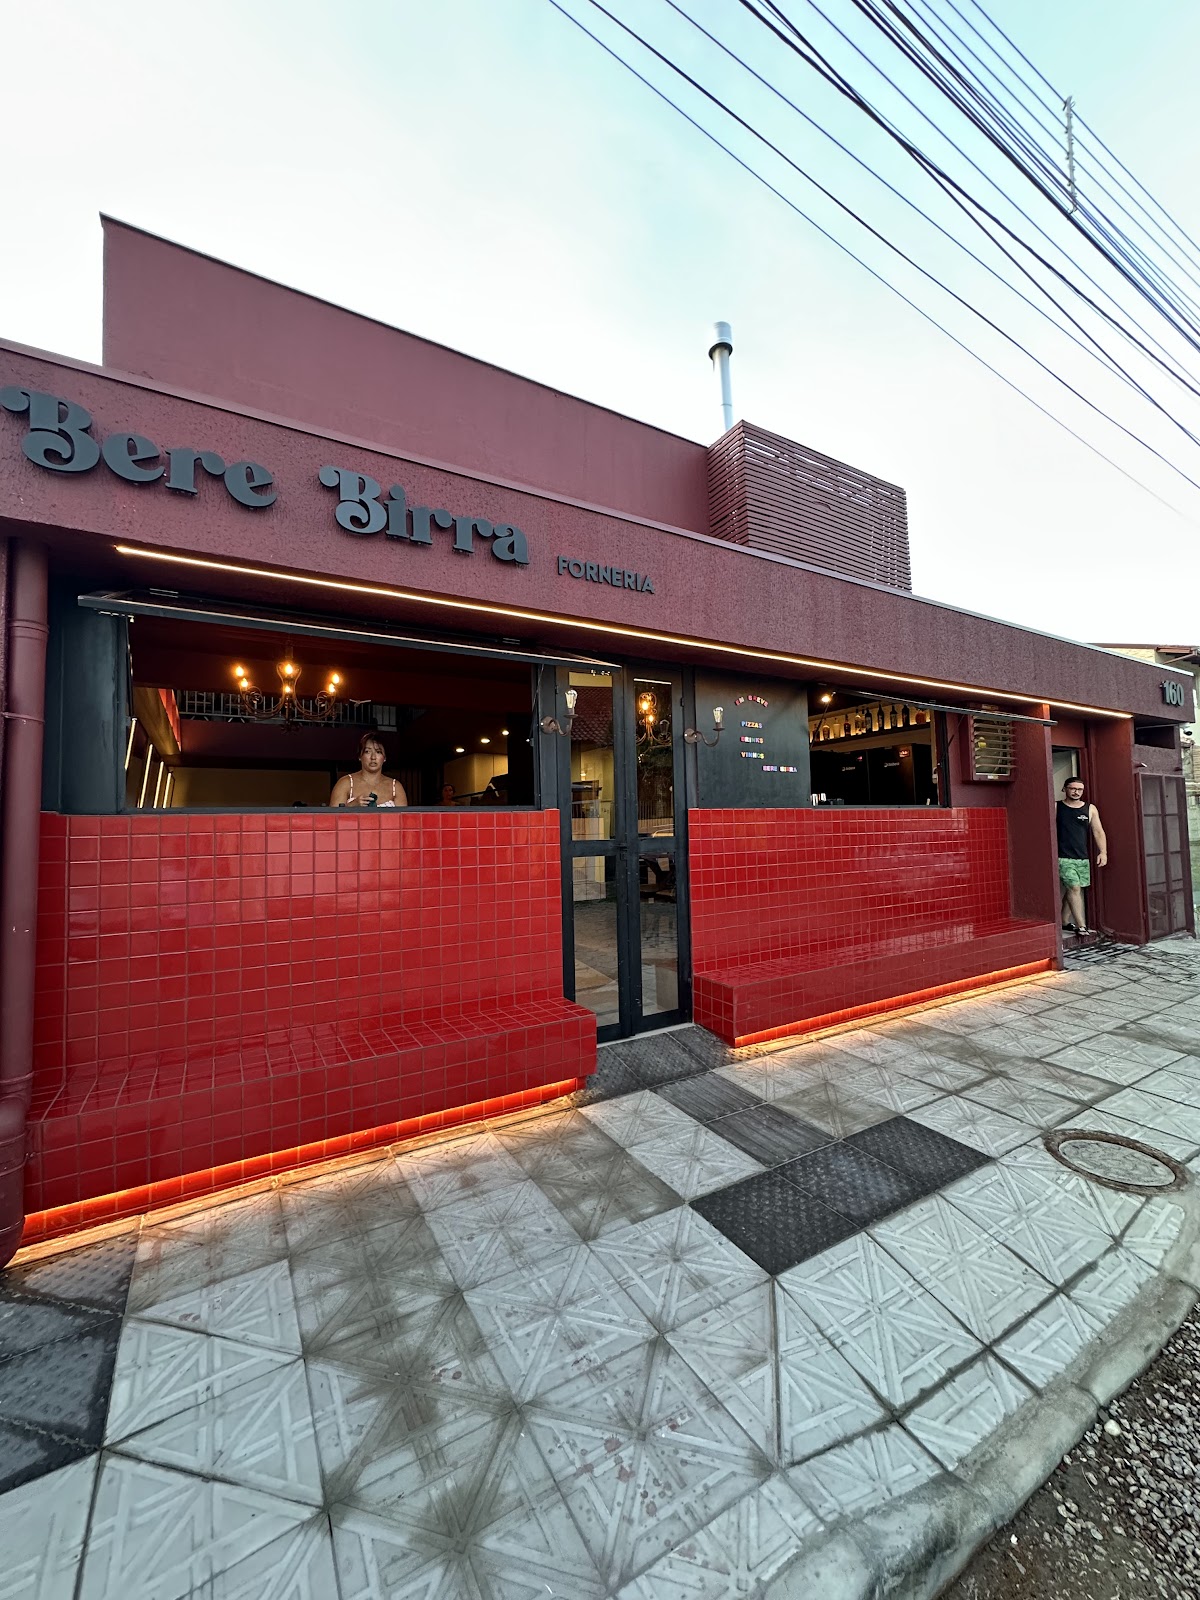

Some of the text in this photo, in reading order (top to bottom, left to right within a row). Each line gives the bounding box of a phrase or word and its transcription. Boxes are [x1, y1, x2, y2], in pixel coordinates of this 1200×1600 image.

[0, 385, 529, 565] Bere Birra
[557, 555, 655, 594] FORNERIA
[1161, 680, 1185, 707] 160
[741, 721, 763, 729] PIZZAS
[740, 736, 764, 744] DRINKS
[741, 752, 765, 760] VINHOS
